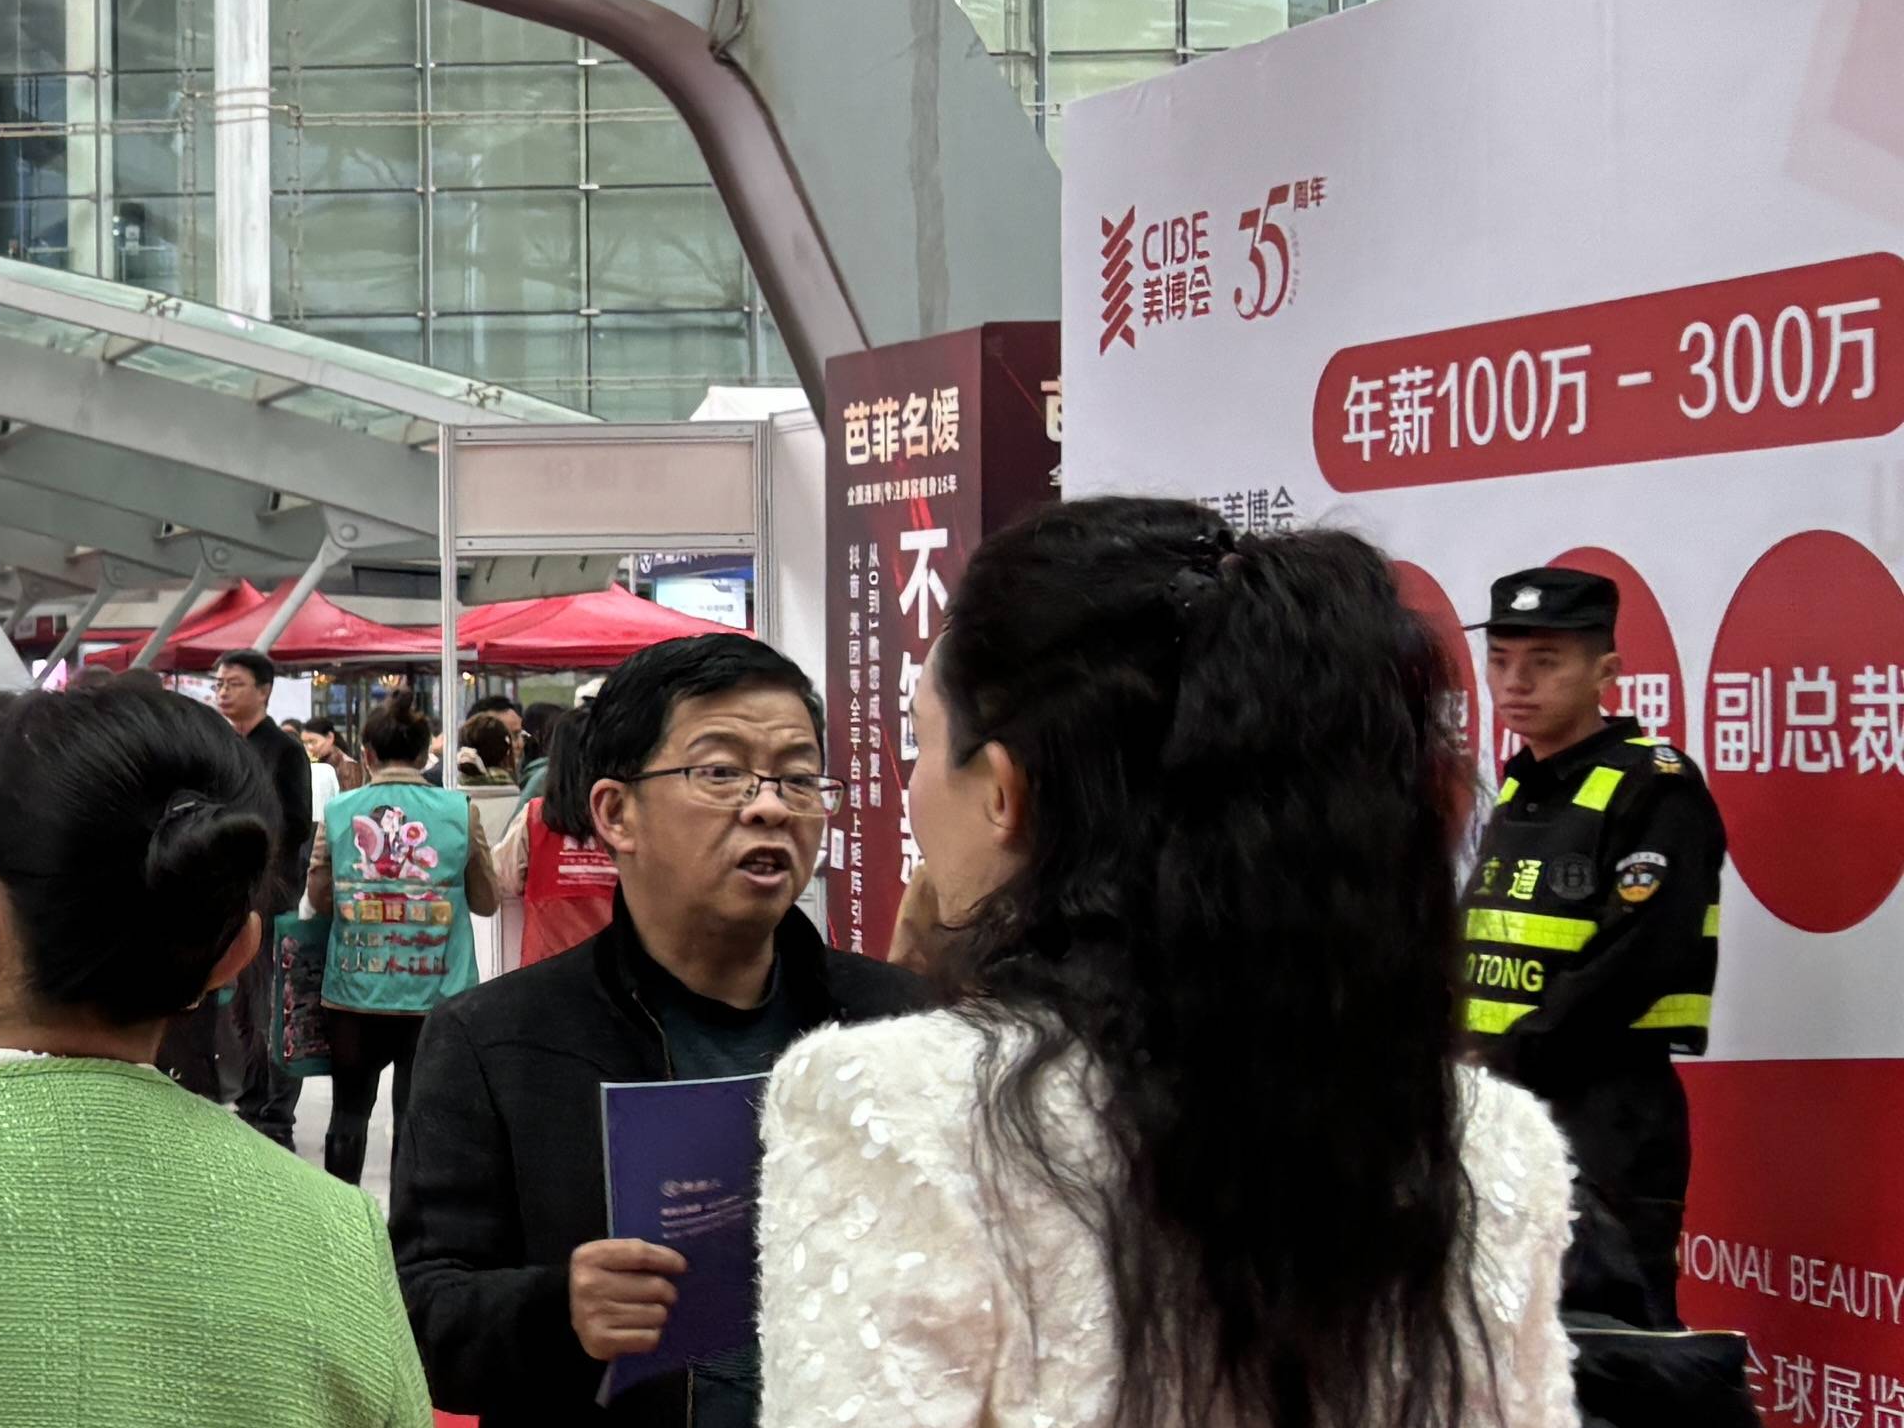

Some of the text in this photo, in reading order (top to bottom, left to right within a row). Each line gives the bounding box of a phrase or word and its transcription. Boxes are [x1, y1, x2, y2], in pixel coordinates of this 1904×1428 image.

[1142, 210, 1211, 271] CIBE
[1142, 265, 1212, 328] 美博会
[1342, 344, 1592, 462] 年薪100万
[1678, 297, 1882, 421] 300万
[843, 386, 960, 465] 芭菲名媛
[1712, 663, 1904, 775] 副总裁
[1675, 1228, 1904, 1325] IONAL BEAUTY
